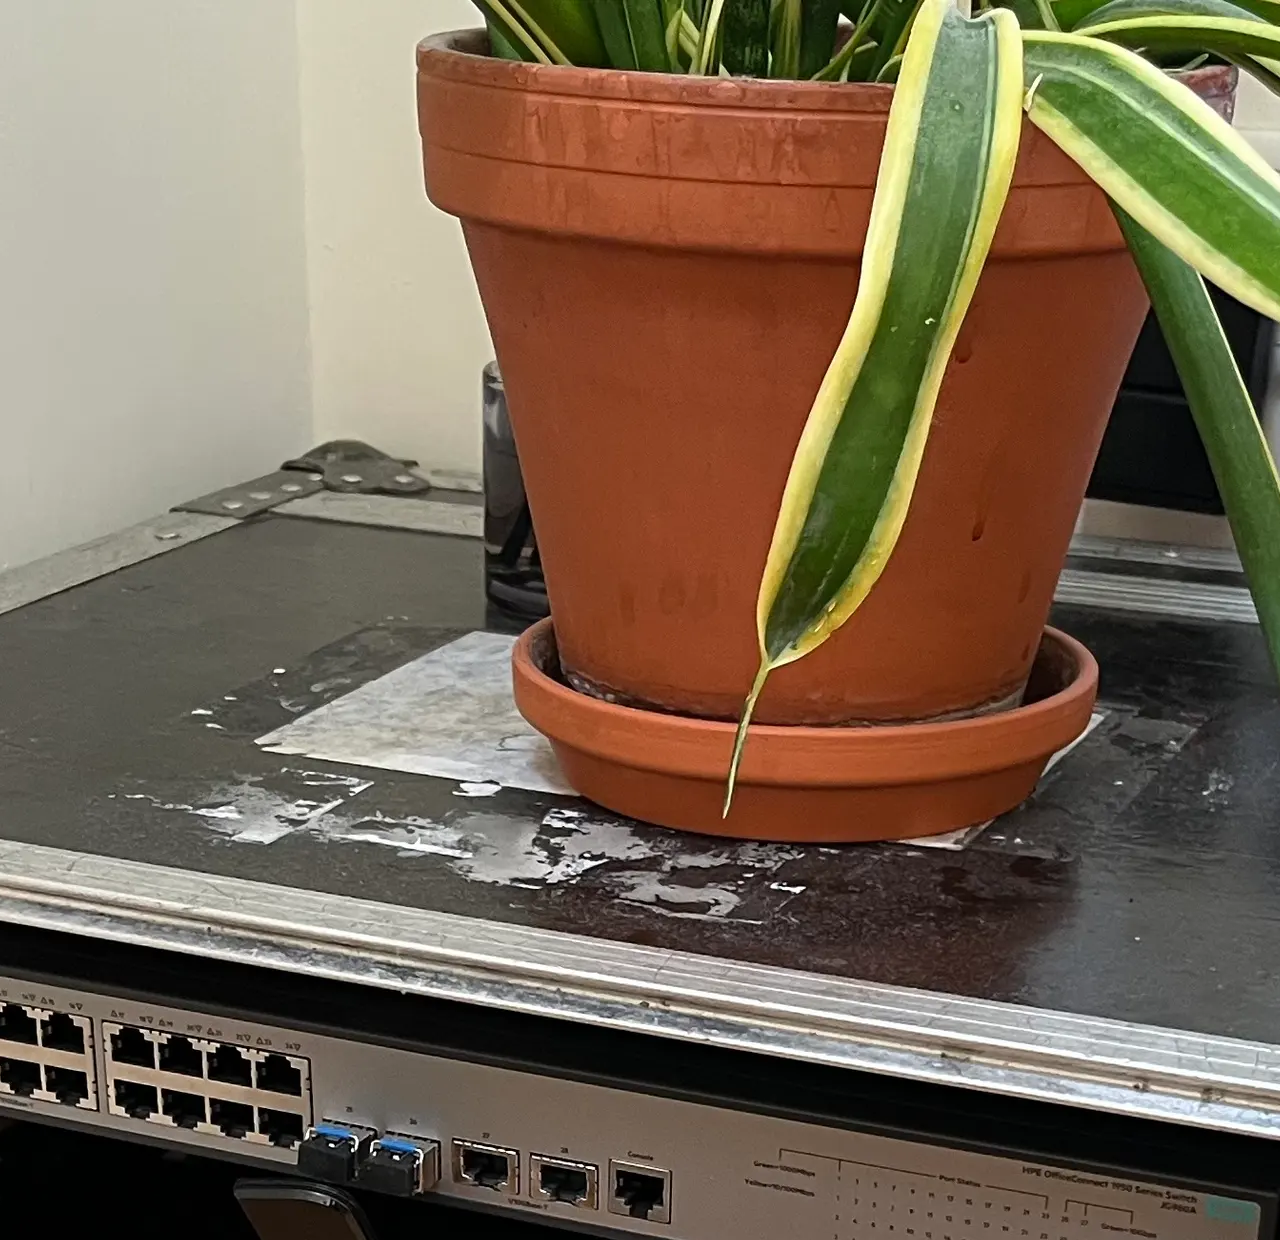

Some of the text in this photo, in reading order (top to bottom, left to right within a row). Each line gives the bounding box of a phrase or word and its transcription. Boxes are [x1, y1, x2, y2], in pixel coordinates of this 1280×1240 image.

[627, 1150, 654, 1161] Console
[1022, 1166, 1198, 1204] HPE OfficeConnect 1950 Series Switch
